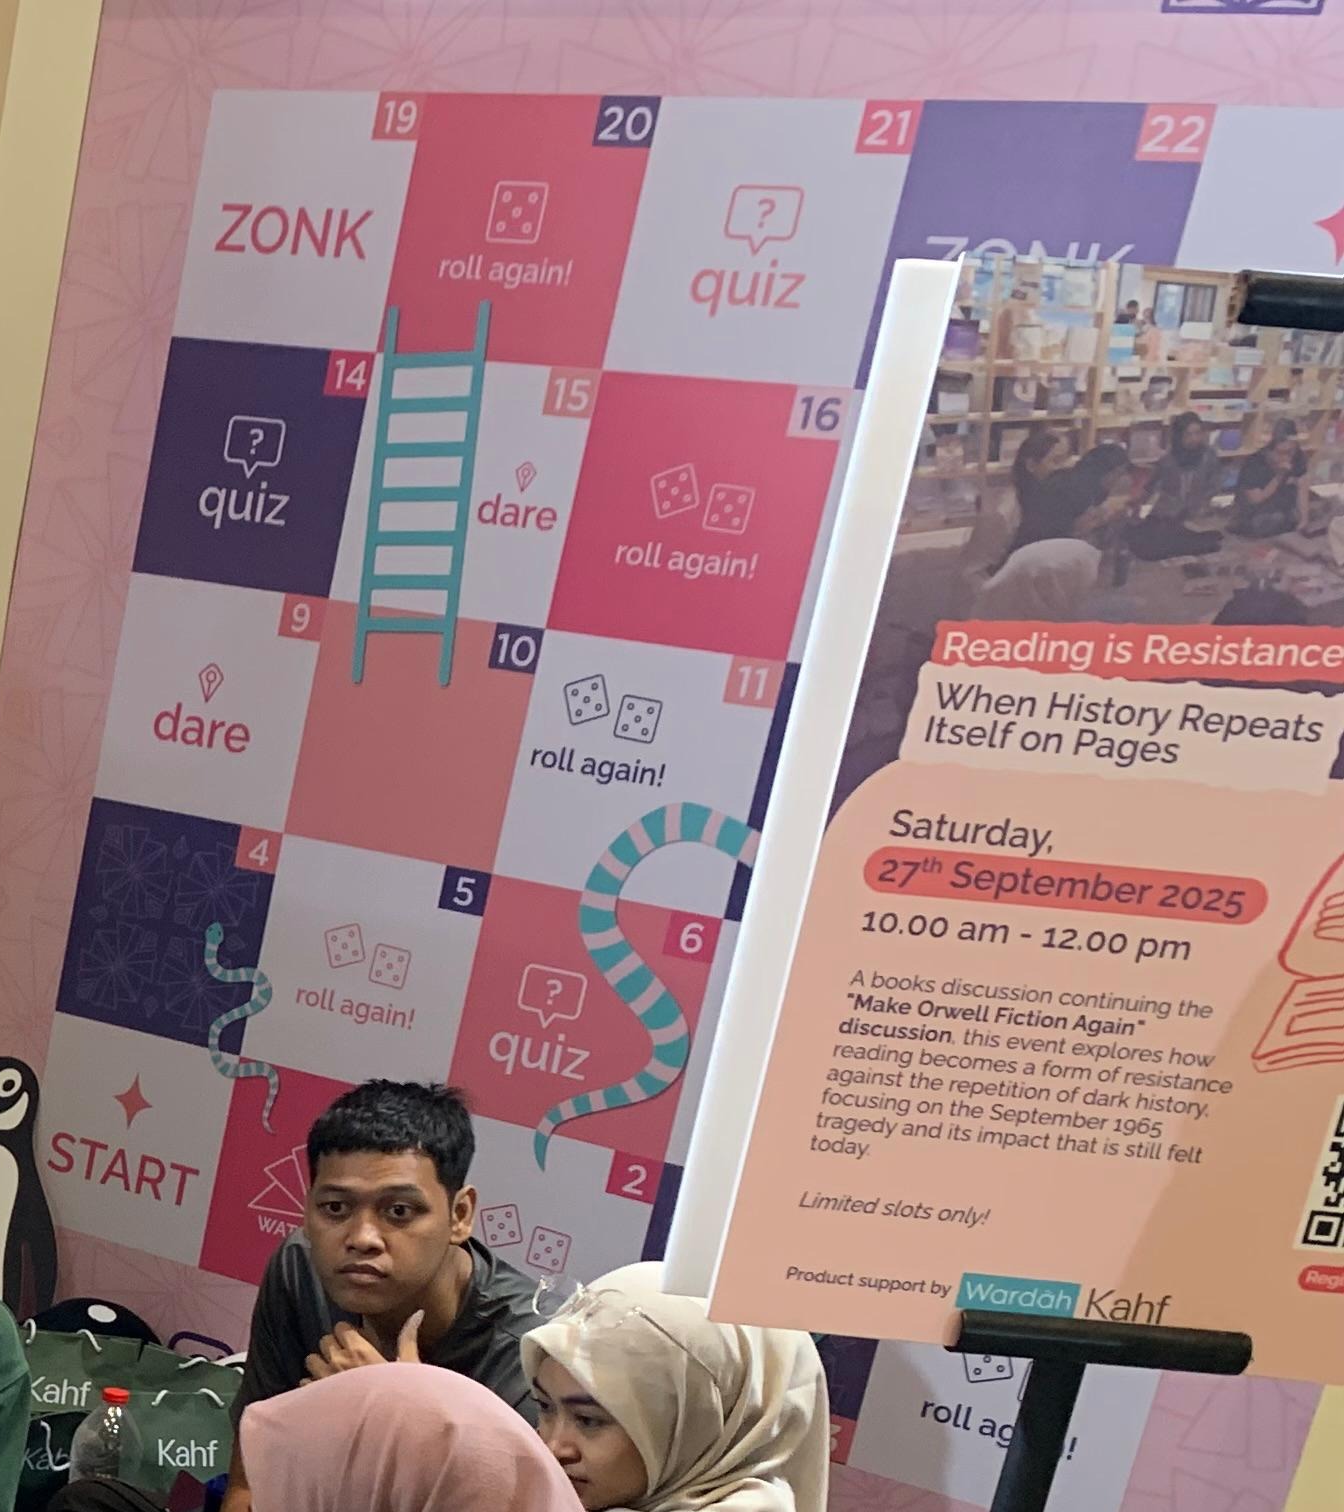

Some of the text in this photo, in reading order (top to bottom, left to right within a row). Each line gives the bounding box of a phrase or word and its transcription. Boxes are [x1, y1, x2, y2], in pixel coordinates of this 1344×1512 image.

[383, 100, 417, 134] 19
[598, 106, 653, 141] 20
[865, 109, 912, 146] 21
[1142, 115, 1206, 153] 22
[215, 203, 373, 260] ZONK
[438, 255, 573, 289] roll again!
[690, 255, 805, 317] quiz
[332, 357, 368, 393] 14
[553, 377, 589, 413] 15
[798, 395, 841, 432] 16
[199, 481, 288, 529] quiz
[477, 491, 557, 532] dare
[615, 543, 758, 583] roll again!
[290, 603, 309, 631] 9
[498, 632, 535, 667] 10
[943, 631, 1344, 670] Reading is Resistance
[736, 667, 768, 700] 11
[154, 705, 251, 753] dare
[936, 682, 1323, 742] When History Repeats
[925, 716, 1179, 767] Itself on Pages
[529, 745, 666, 788] roll again!
[890, 809, 1053, 856] Saturday,
[249, 840, 270, 866] 4
[453, 877, 475, 906] 5
[878, 856, 1245, 919] 27th September 2025
[679, 924, 703, 953] 6
[862, 912, 1191, 962] 10.00 am 12.00 pm
[296, 984, 415, 1030] roll again!
[849, 969, 1213, 1019] A books discussion continuing the
[847, 993, 1146, 1037] "Make Orwell Fiction Again"
[489, 1030, 590, 1080] quiz
[963, 1029, 1000, 1048] this
[1007, 1036, 1066, 1055] event
[1072, 1042, 1163, 1063] explores
[1169, 1048, 1216, 1067] how
[826, 1067, 903, 1088] against
[910, 1072, 943, 1090] the
[949, 1077, 1050, 1101] repetition
[1056, 1086, 1079, 1103] of
[1083, 1089, 1131, 1108] dark
[832, 1044, 1233, 1094] reading becomes a form of resistance
[821, 1087, 1163, 1138] focusing on the September 1965
[816, 1112, 1202, 1164] tragedy and its impact that is still felt
[48, 1131, 200, 1206] START
[623, 1167, 645, 1194] 2
[798, 1191, 990, 1229] Limited slots only!
[786, 1266, 854, 1287] Product
[858, 1274, 926, 1295] support
[930, 1281, 952, 1298] by
[1085, 1288, 1172, 1325] Kahf
[31, 1377, 91, 1406] Kahf
[920, 1399, 972, 1431] roll
[158, 1439, 218, 1467] Kahf
